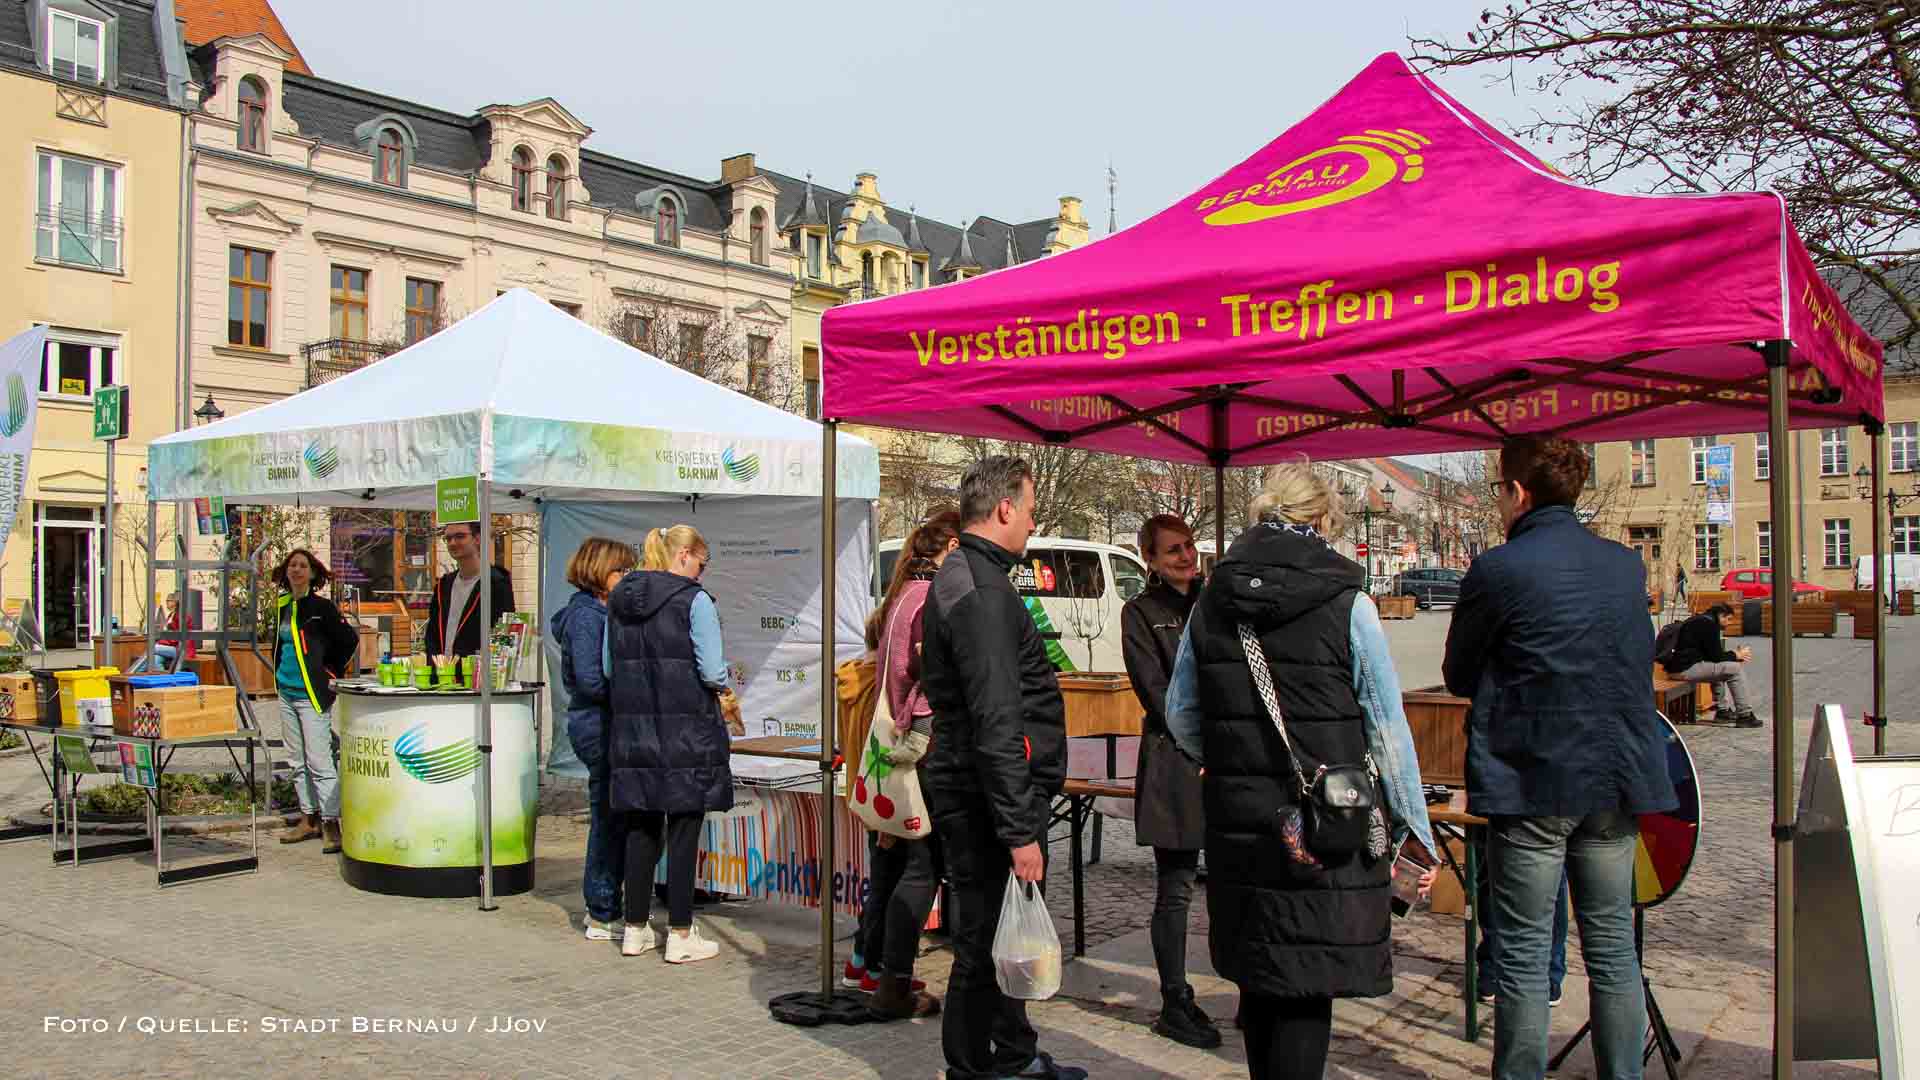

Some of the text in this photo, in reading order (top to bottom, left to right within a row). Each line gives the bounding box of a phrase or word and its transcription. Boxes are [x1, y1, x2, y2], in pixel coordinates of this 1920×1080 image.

[1197, 164, 1349, 211] BERNAU
[909, 308, 1181, 367] Verständigen
[1220, 278, 1394, 341] Treffen
[1444, 256, 1621, 314] Dialog
[655, 447, 719, 467] KREISWERKE
[678, 466, 719, 481] BARNIM
